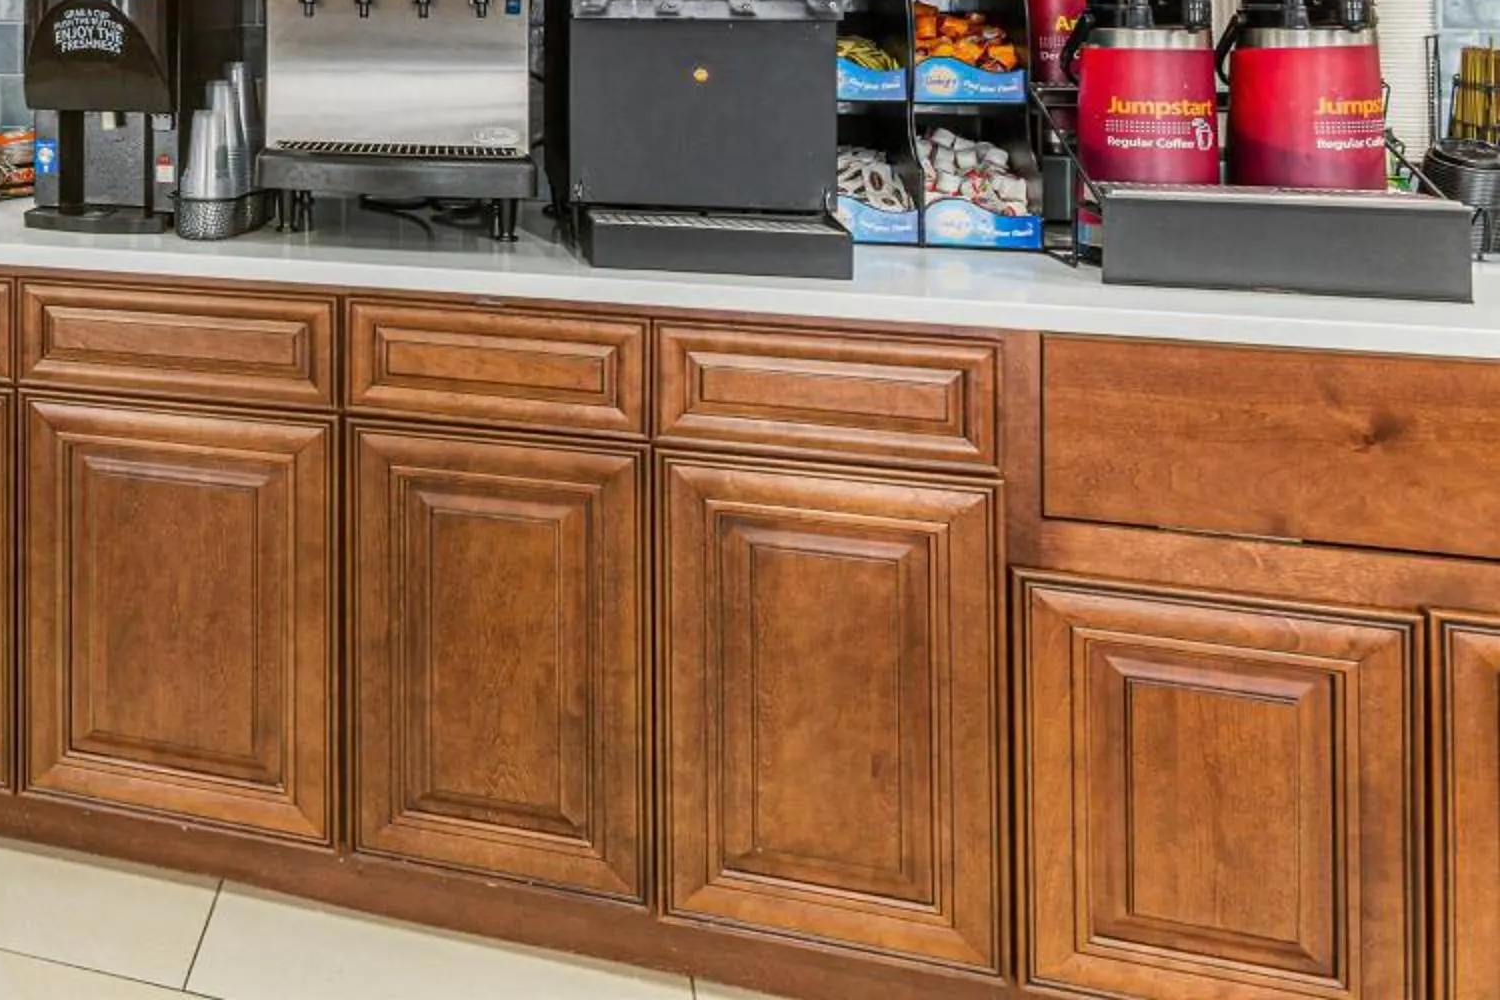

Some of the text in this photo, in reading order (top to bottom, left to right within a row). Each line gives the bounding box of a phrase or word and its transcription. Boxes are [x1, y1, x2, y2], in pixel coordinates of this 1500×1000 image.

[55, 26, 93, 44] ENJOY
[1107, 96, 1212, 120] Jumpstart
[1107, 136, 1154, 149] Regular
